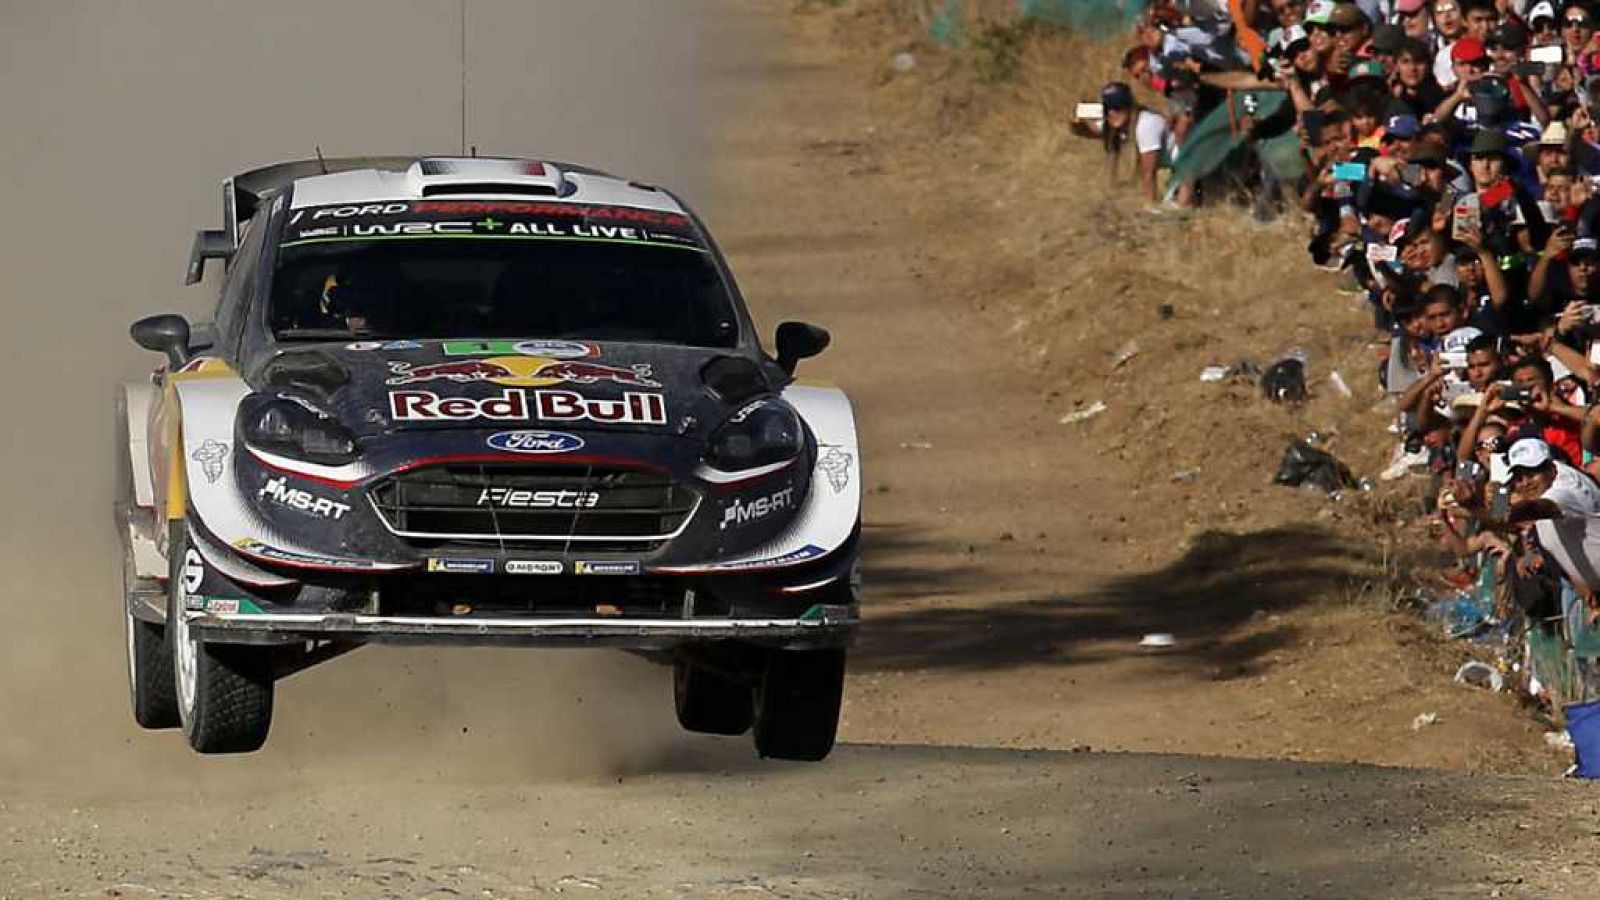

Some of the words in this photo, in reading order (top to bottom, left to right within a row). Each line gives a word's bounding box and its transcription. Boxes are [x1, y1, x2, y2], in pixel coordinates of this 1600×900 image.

[313, 203, 408, 219] FORD
[510, 222, 565, 235] ALL
[573, 224, 638, 239] LIVE
[390, 389, 528, 420] Red
[535, 390, 667, 424] Bull
[504, 432, 565, 450] Ford
[275, 484, 350, 519] MS-RT
[478, 488, 600, 508] Fiesta
[737, 488, 793, 524] MS-RT
